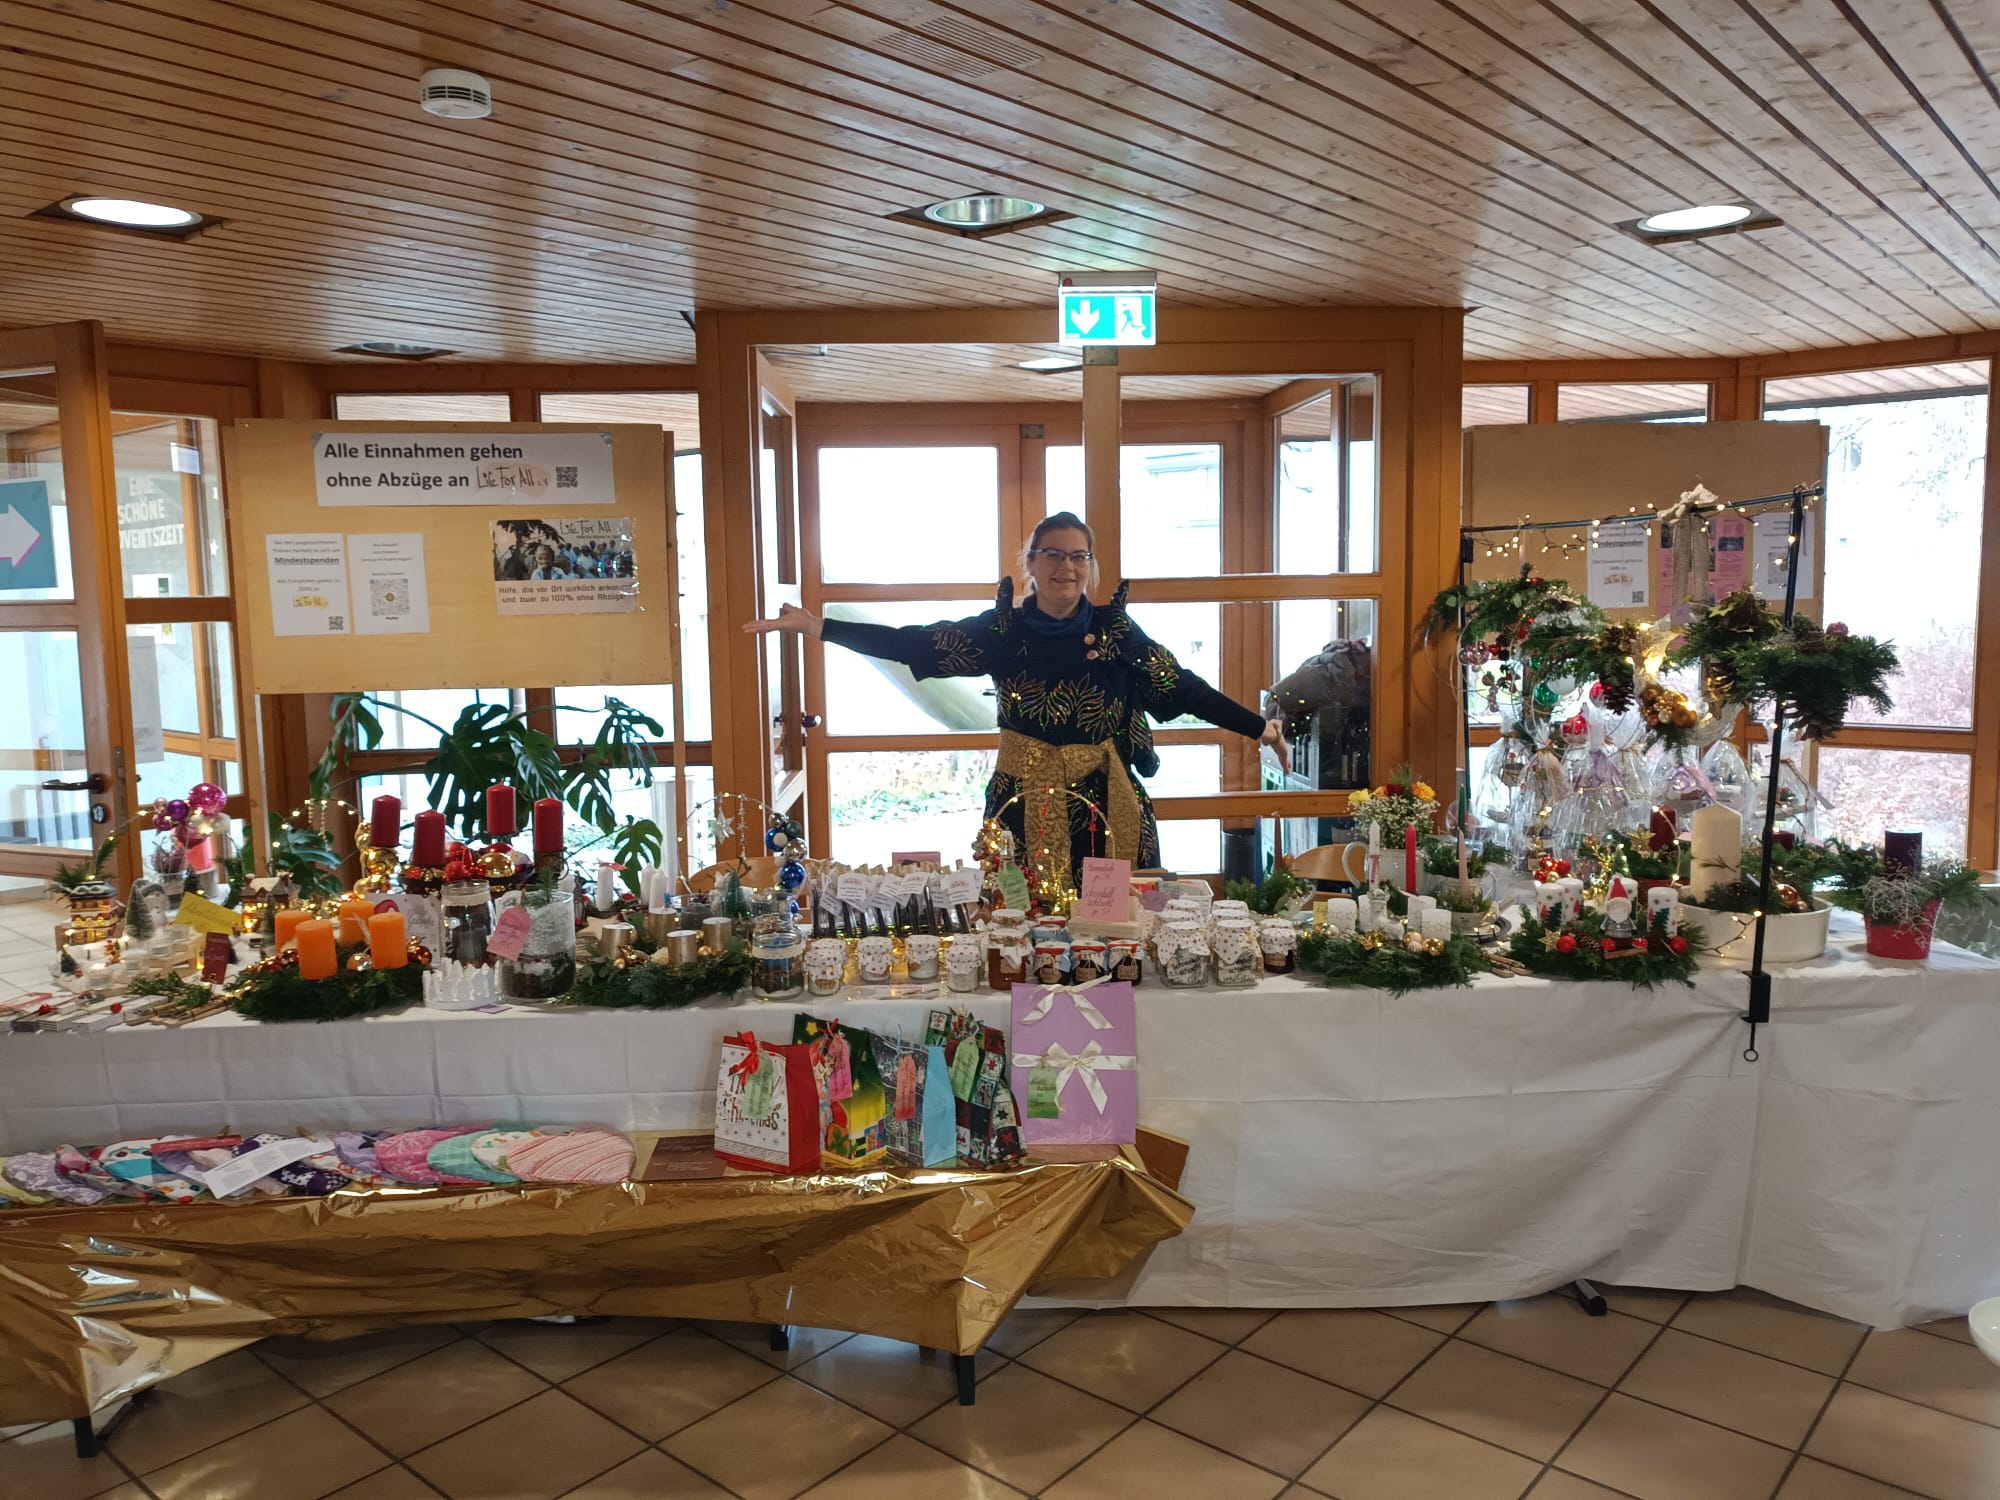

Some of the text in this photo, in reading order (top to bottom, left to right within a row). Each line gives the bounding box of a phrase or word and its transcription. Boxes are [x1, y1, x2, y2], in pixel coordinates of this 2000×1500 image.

[324, 443, 523, 462] Alle Einnahmen gehen
[326, 472, 372, 488] ohne
[378, 472, 443, 491] Abzüge
[448, 475, 469, 488] an
[495, 466, 516, 488] For
[519, 467, 534, 488] All
[118, 496, 166, 524] SCHÖNE
[274, 557, 340, 566] Mindestspenden
[522, 585, 534, 594] die
[551, 585, 562, 593] Ort
[565, 584, 595, 593] wirklich
[552, 594, 574, 602] 100%
